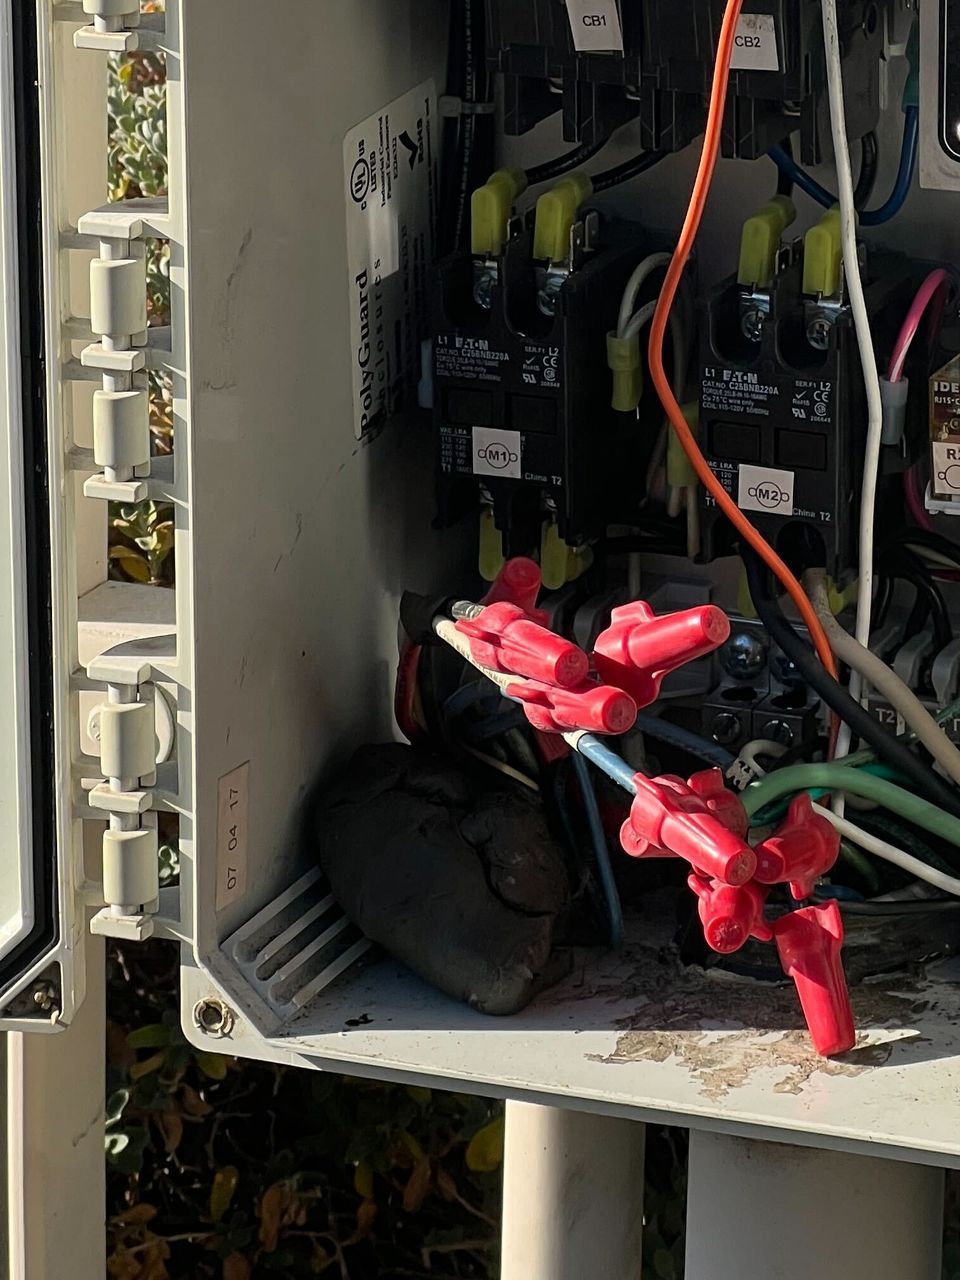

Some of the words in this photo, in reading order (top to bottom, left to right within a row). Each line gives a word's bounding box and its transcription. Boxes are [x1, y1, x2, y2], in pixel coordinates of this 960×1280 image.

[581, 14, 607, 27] CB1
[734, 34, 762, 49] CB2
[437, 335, 447, 344] L1
[548, 346, 560, 356] L2
[705, 367, 715, 376] L1
[819, 381, 831, 391] L2
[488, 450, 506, 461] M1
[524, 472, 547, 482] China
[551, 475, 562, 485] T2
[758, 488, 779, 501] M2
[819, 511, 831, 521] T2
[875, 707, 895, 724] T2
[229, 788, 239, 810] 17
[228, 825, 237, 850] 04
[227, 867, 237, 889] 07
